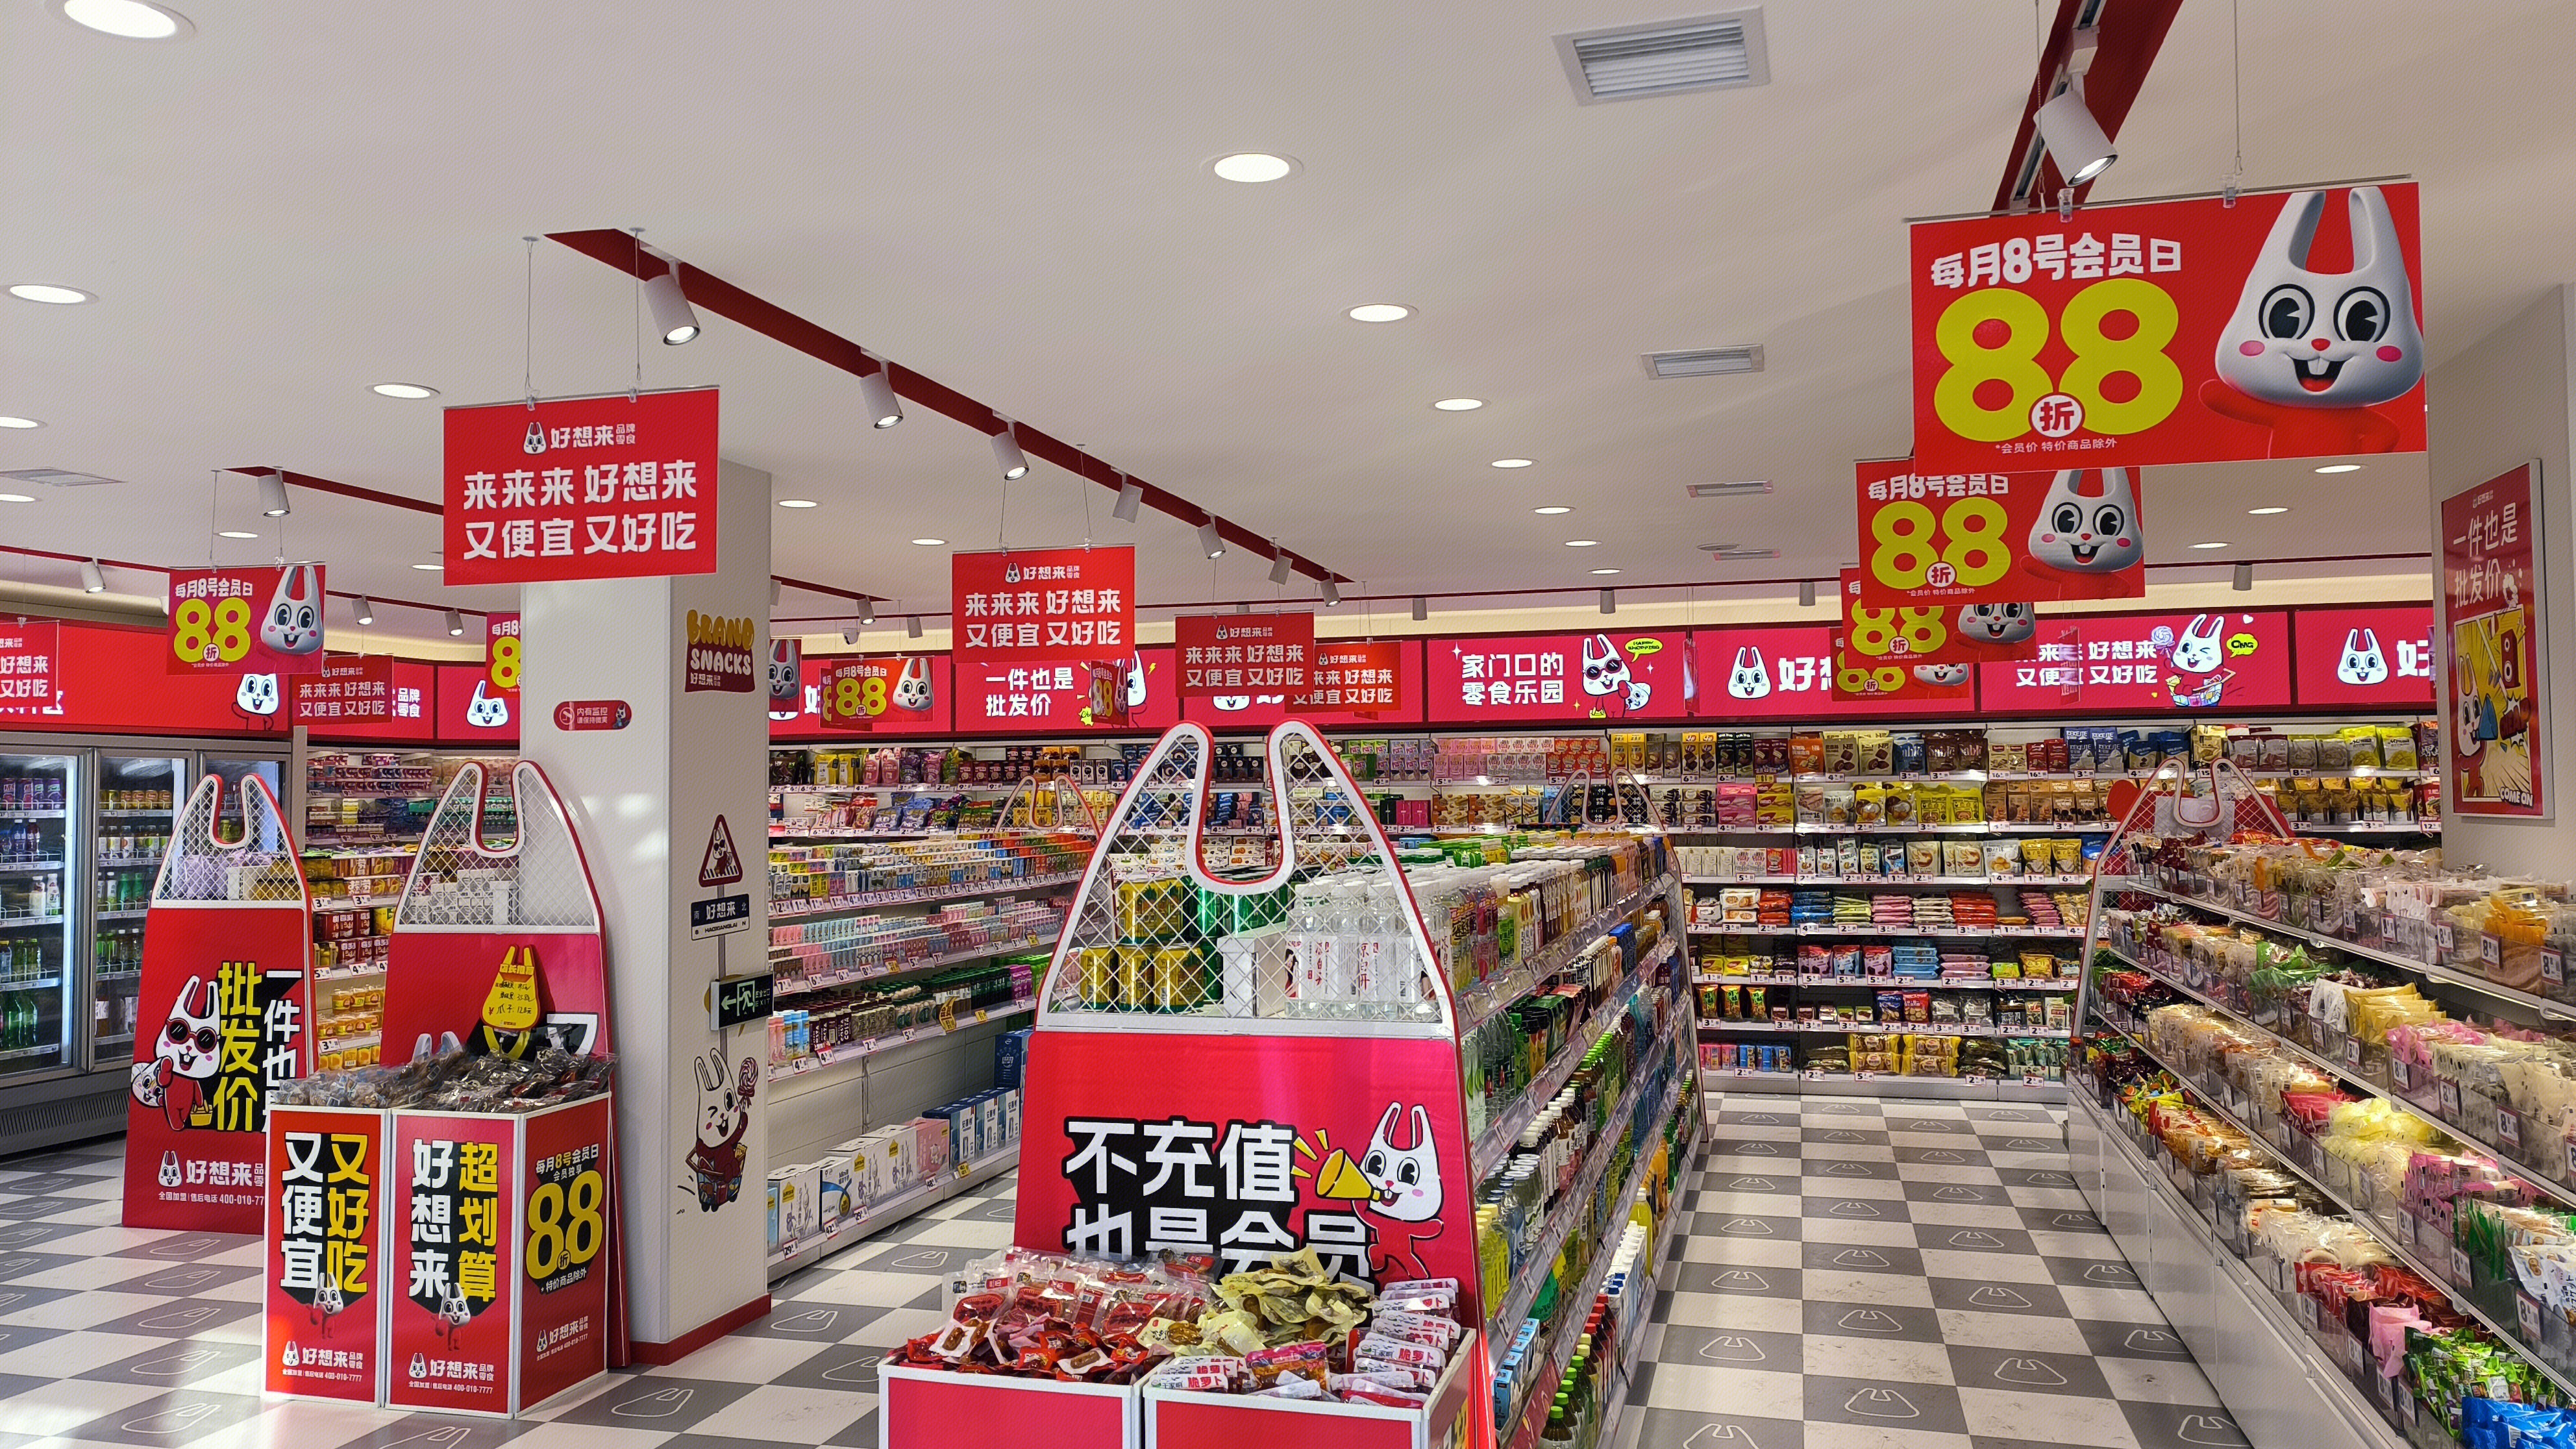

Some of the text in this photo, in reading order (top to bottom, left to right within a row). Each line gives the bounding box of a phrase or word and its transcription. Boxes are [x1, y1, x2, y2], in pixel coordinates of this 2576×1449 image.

[1931, 232, 2181, 288] 每月8号会员日
[1934, 278, 2183, 442] 88
[2040, 400, 2075, 432] 折
[551, 425, 614, 449] 好想来
[616, 423, 636, 434] 品牌
[2041, 437, 2118, 452] 特价商品除外
[463, 459, 697, 510] 来来来 好想来
[1868, 475, 2009, 501] 每月8号会员日
[463, 511, 697, 560] 又便宜 又好吃
[2453, 502, 2518, 558] 一件也是
[1871, 497, 2011, 589] 88
[1023, 565, 1066, 580] 好想来
[1931, 566, 1951, 584] 折
[2455, 558, 2502, 609] 批发价
[175, 578, 253, 598] 每月8号会员日
[965, 589, 1121, 617] 来来来 好想来
[174, 597, 251, 662] 88
[492, 620, 520, 636] 每月8
[965, 621, 1121, 648] 又便宜 又好吃
[1229, 627, 1262, 638] 好想来
[205, 647, 217, 659] 折
[1185, 644, 1304, 664] 来来来 好想来
[1892, 639, 1905, 651] 折
[2088, 640, 2157, 660] 好想来
[0, 655, 48, 675] 好想来
[691, 649, 751, 675] SNACKS
[1462, 653, 1564, 678] 家门口的
[985, 668, 1074, 691] 一件也是
[1185, 667, 1304, 687] 又便宜 又好吃
[1344, 669, 1393, 685] 好想来
[2089, 665, 2158, 684] 又好吃
[0, 679, 48, 698] 又好吃
[299, 681, 385, 698] 来来来 好想来
[397, 687, 420, 703] 品牌
[836, 676, 887, 716] 88
[1344, 688, 1393, 704] 又好吃
[1462, 680, 1564, 705] 零食乐园
[299, 700, 385, 717] 又便宜 又好吃
[985, 693, 1051, 717] 批发价
[2500, 786, 2533, 806] COME ON
[706, 901, 736, 920] 好想来
[213, 961, 262, 1131] 批发价
[536, 1143, 599, 1174] 每月8号会员日
[1066, 1119, 1294, 1202] 不充值
[186, 1159, 252, 1186] 好想来
[553, 1164, 582, 1182] 会员独享
[280, 1132, 323, 1289] 又便宜
[327, 1133, 369, 1293] 又好吃
[409, 1139, 454, 1299] 好想来
[458, 1141, 498, 1302] 超划算
[526, 1170, 603, 1280] 88
[559, 1253, 569, 1268] 折
[549, 1320, 578, 1345] 好想来
[302, 1347, 347, 1368] 好想来
[430, 1359, 478, 1380] 好想来
[1188, 1376, 1221, 1388] 脆萝卜
